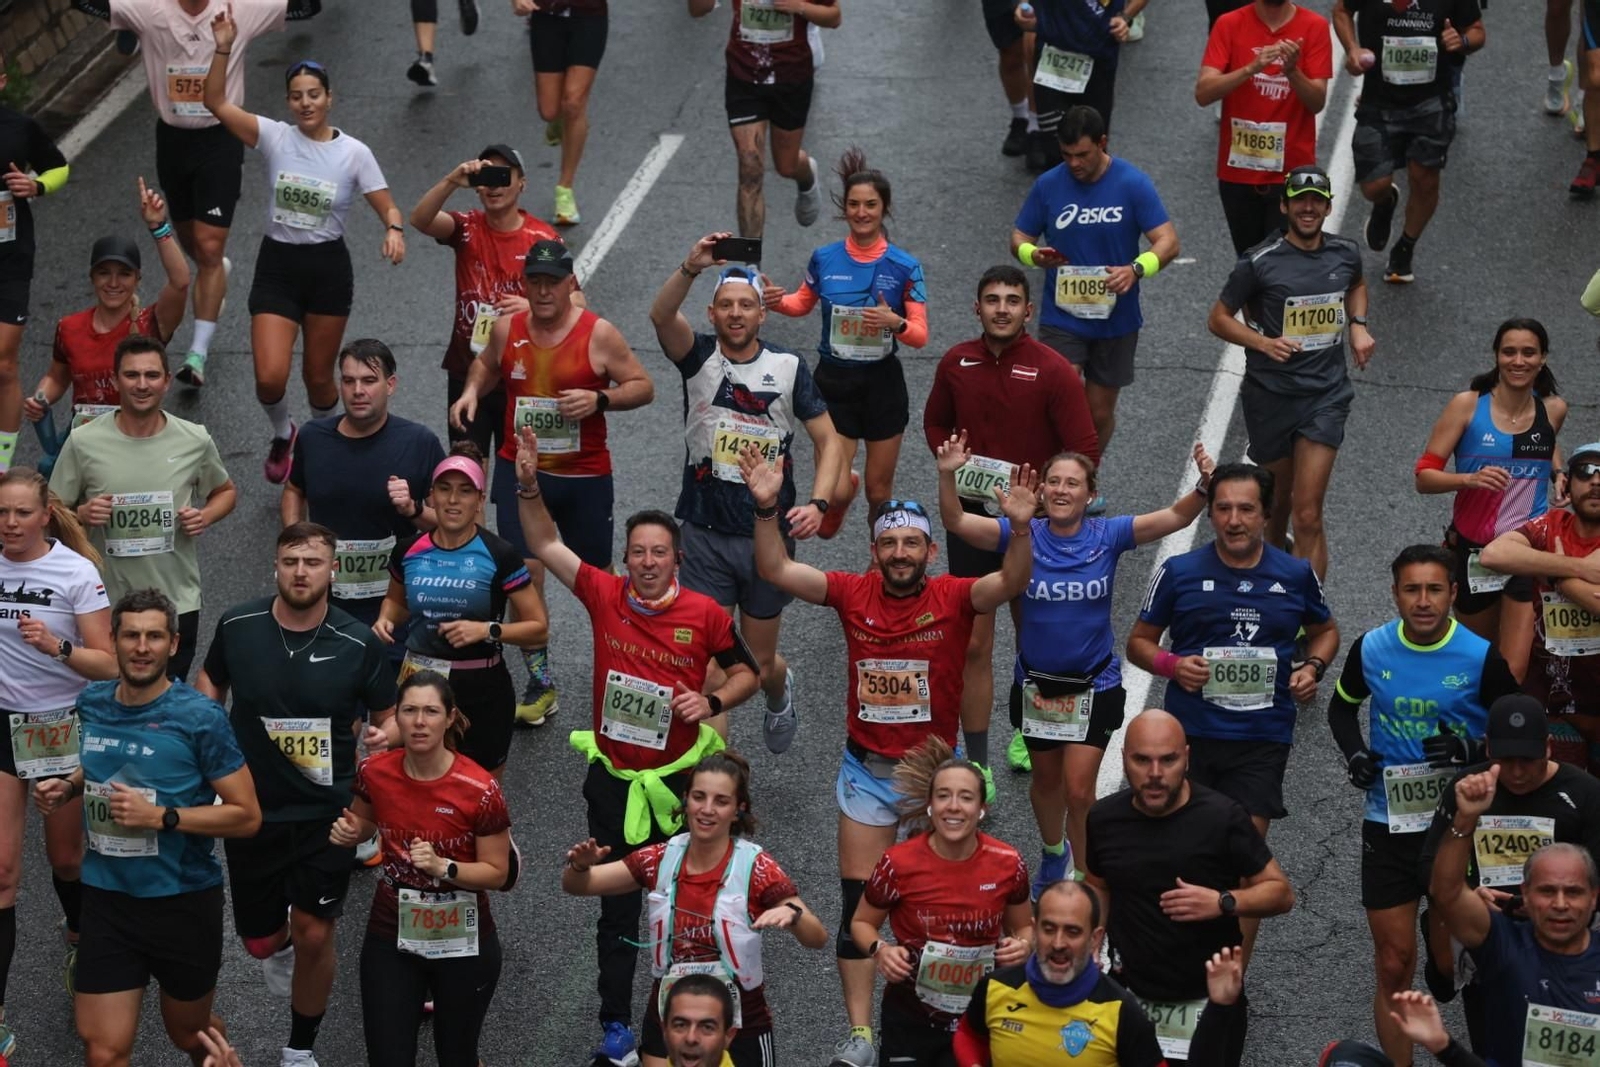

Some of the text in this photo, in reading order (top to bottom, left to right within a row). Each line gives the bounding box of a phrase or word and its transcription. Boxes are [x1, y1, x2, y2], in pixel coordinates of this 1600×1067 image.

[1387, 19, 1434, 30] RUNNING
[1046, 51, 1084, 73] 10247
[1387, 49, 1428, 64] 10248
[176, 78, 204, 95] 575
[1236, 131, 1275, 150] 11863
[283, 185, 320, 208] 6535
[1077, 206, 1123, 224] asics
[1060, 279, 1106, 297] 11089
[1289, 306, 1335, 327] 11700
[525, 412, 564, 429] 9599
[957, 468, 1005, 491] 10076
[109, 507, 163, 530] 10284
[337, 555, 388, 575] 10272
[411, 574, 477, 590] anthus
[1214, 663, 1261, 684] 6658
[867, 675, 912, 696] 5304
[611, 689, 656, 718] 8214
[1394, 696, 1438, 718] CDC
[23, 723, 72, 749] 7127
[1480, 833, 1542, 855] 12403
[410, 906, 459, 930] 7834
[928, 960, 984, 984] 10061
[1538, 1026, 1595, 1057] 8184
